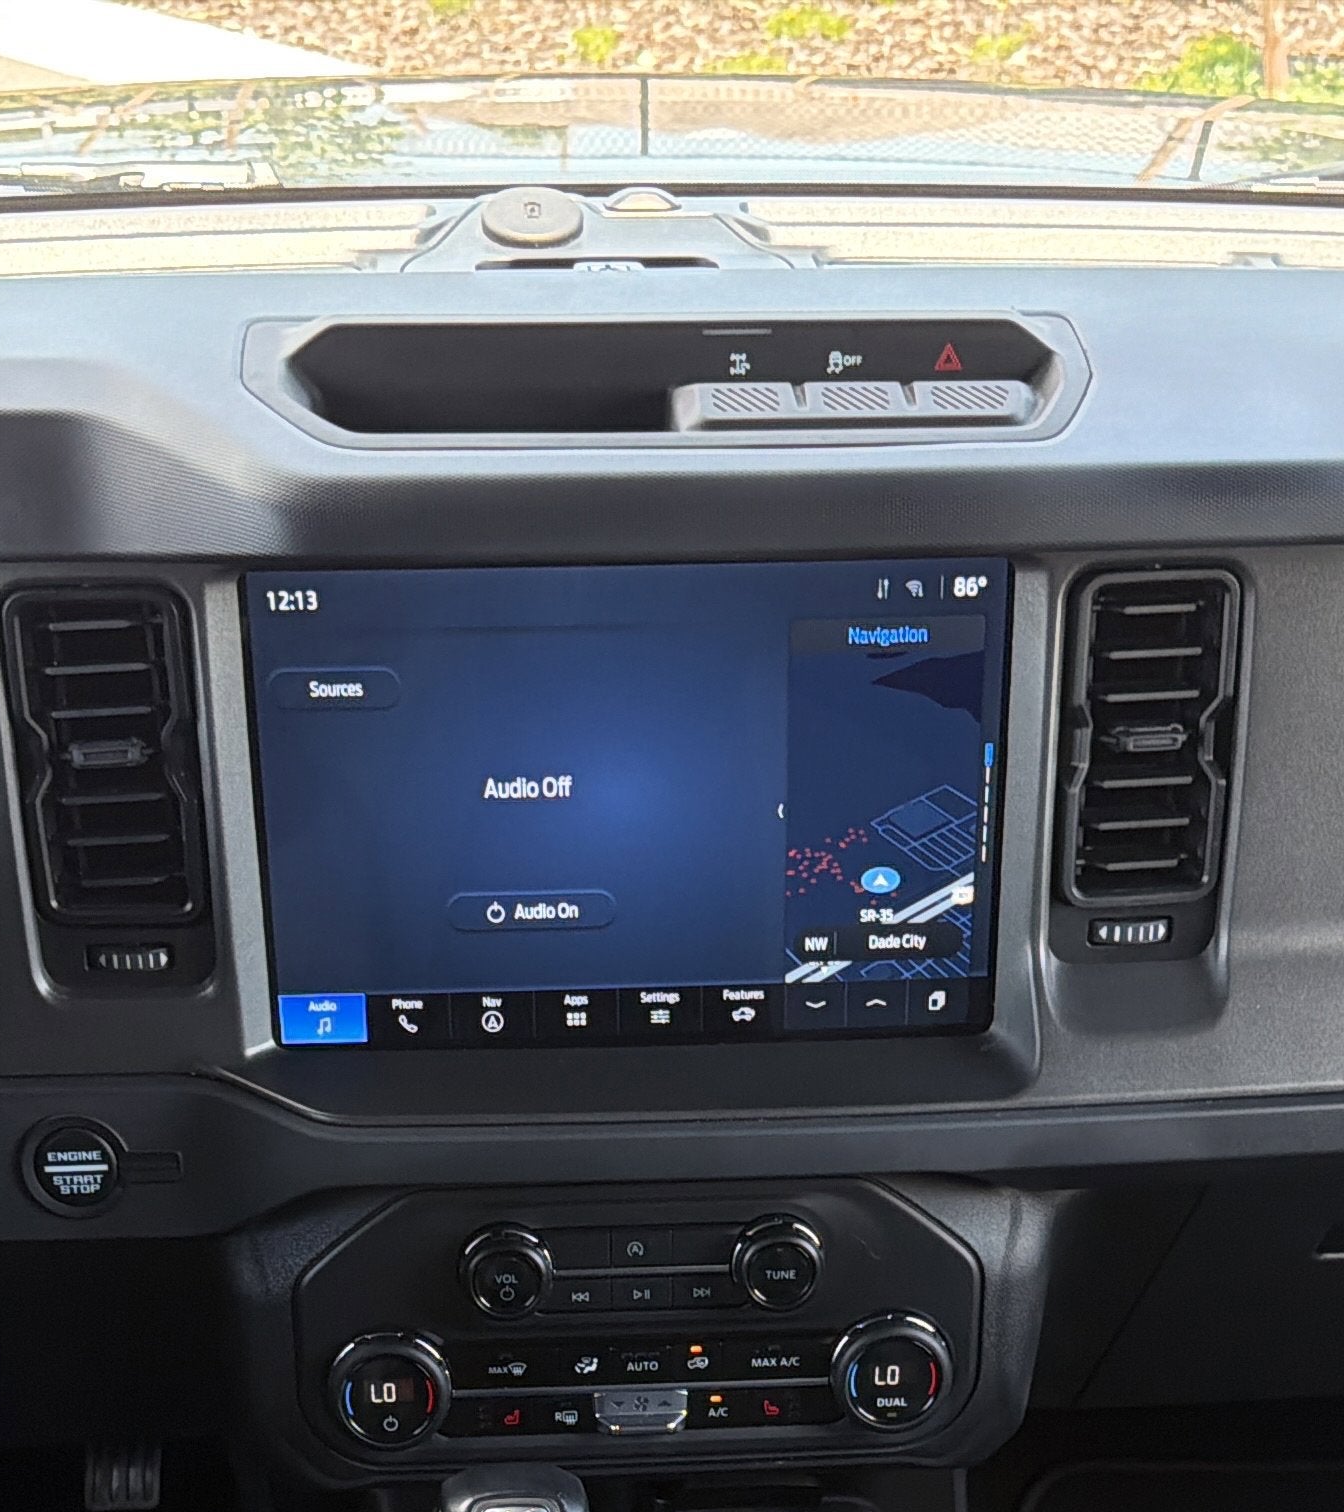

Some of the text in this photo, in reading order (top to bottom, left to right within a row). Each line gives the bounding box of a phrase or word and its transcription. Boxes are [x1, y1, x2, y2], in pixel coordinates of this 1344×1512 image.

[843, 354, 863, 367] OFF
[953, 575, 988, 597] 86°
[266, 590, 318, 612] 12:13
[848, 625, 928, 646] Navigation
[309, 681, 364, 698] Sources
[484, 775, 572, 799] Audio Off
[514, 902, 579, 920] Audio On
[859, 909, 894, 923] SR-35
[804, 936, 828, 951] NW
[868, 933, 927, 950] Dade City
[564, 993, 589, 1007] Apps
[640, 991, 680, 1004] Settings
[722, 988, 765, 1001] Features
[308, 1000, 337, 1011] Audio
[391, 998, 423, 1010] Phone
[482, 996, 502, 1007] Nav
[47, 1150, 102, 1162] ENGINE
[53, 1174, 104, 1185] START
[60, 1184, 101, 1195] STOP
[494, 1274, 518, 1285] VOL
[765, 1269, 797, 1280] TUNE
[626, 1360, 659, 1372] AUTO
[751, 1356, 801, 1368] MAX A/C
[488, 1366, 509, 1374] MAX
[876, 1397, 908, 1408] DUAL
[708, 1407, 728, 1417] A/C
